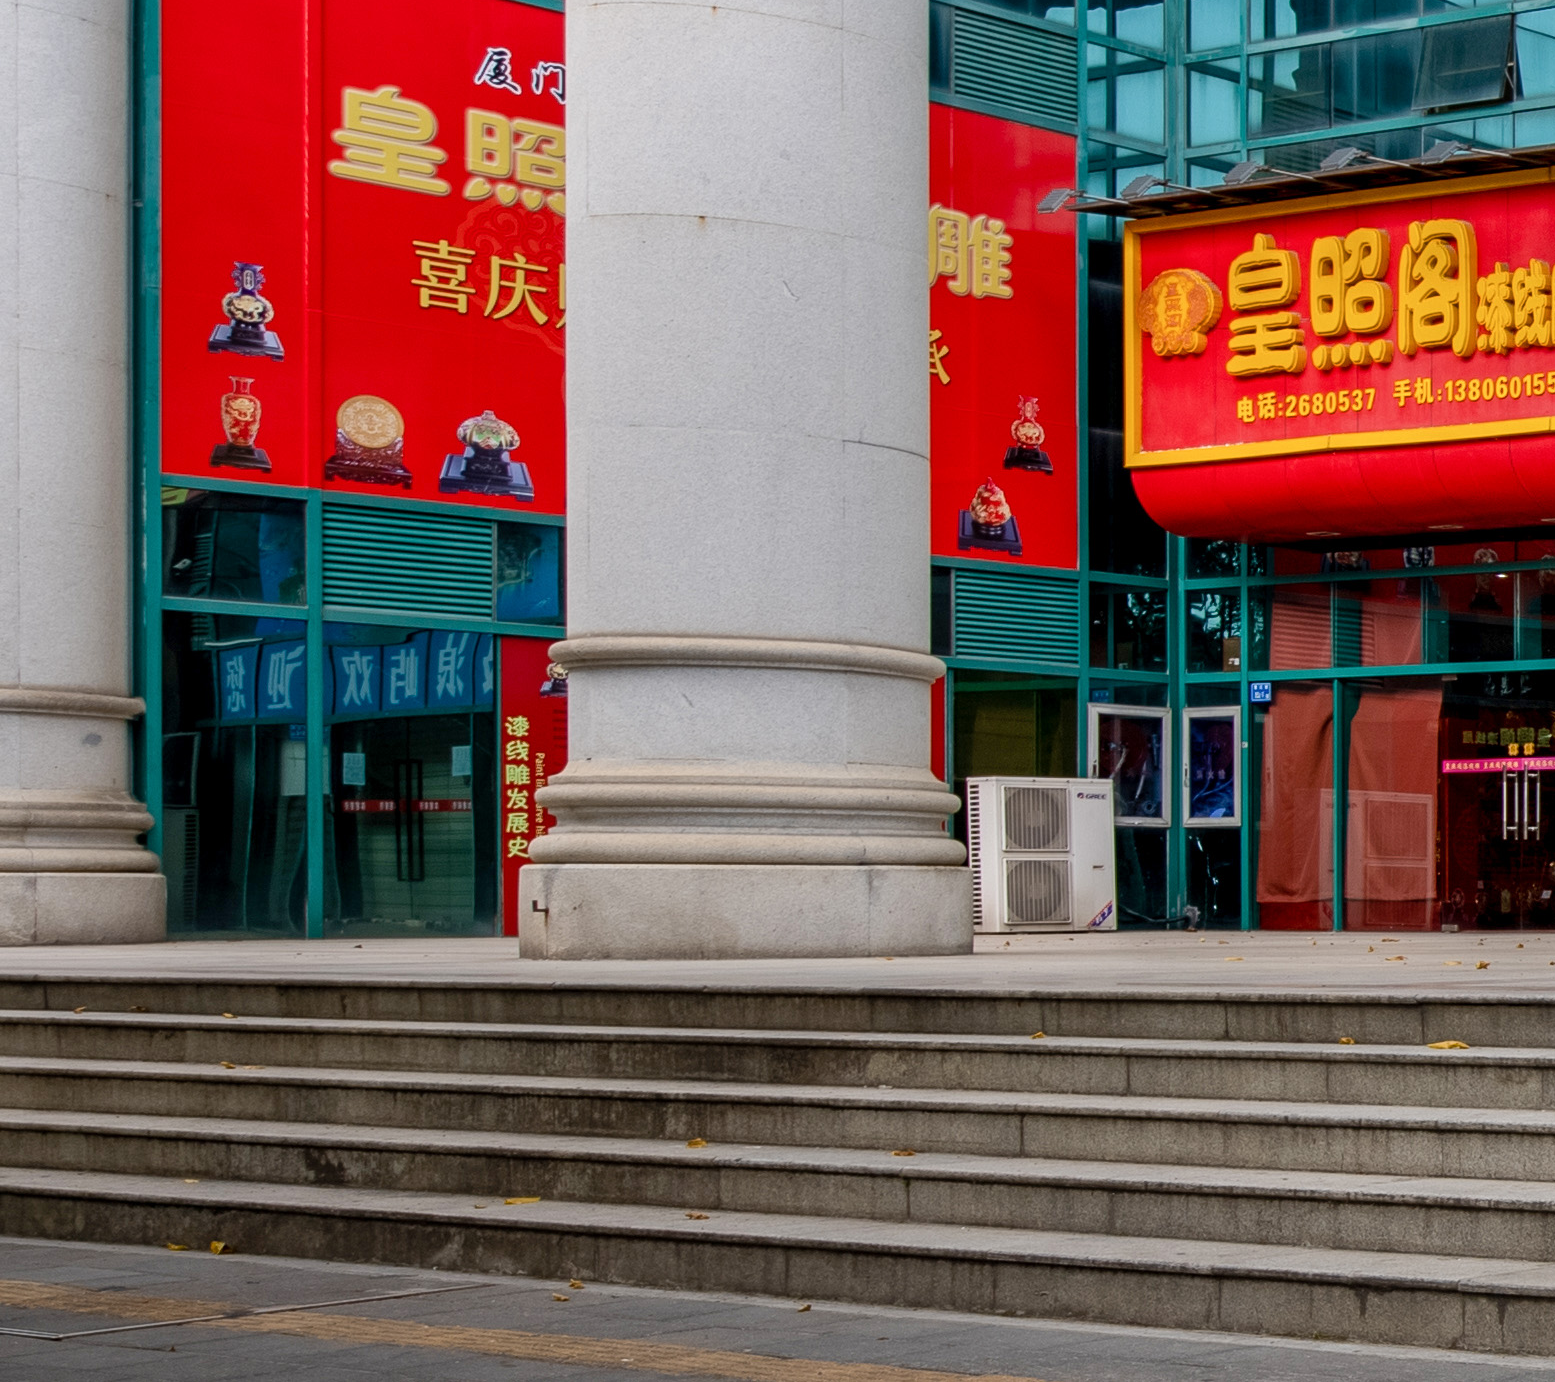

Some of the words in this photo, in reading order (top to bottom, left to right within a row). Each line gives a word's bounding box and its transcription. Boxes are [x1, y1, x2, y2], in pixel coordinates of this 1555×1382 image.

[410, 239, 566, 329] 喜庆
[929, 203, 1014, 300] 雕
[1237, 387, 1377, 423] 电话:2680537
[504, 715, 531, 859] 漆线雕发展史
[535, 752, 546, 777] Paint
